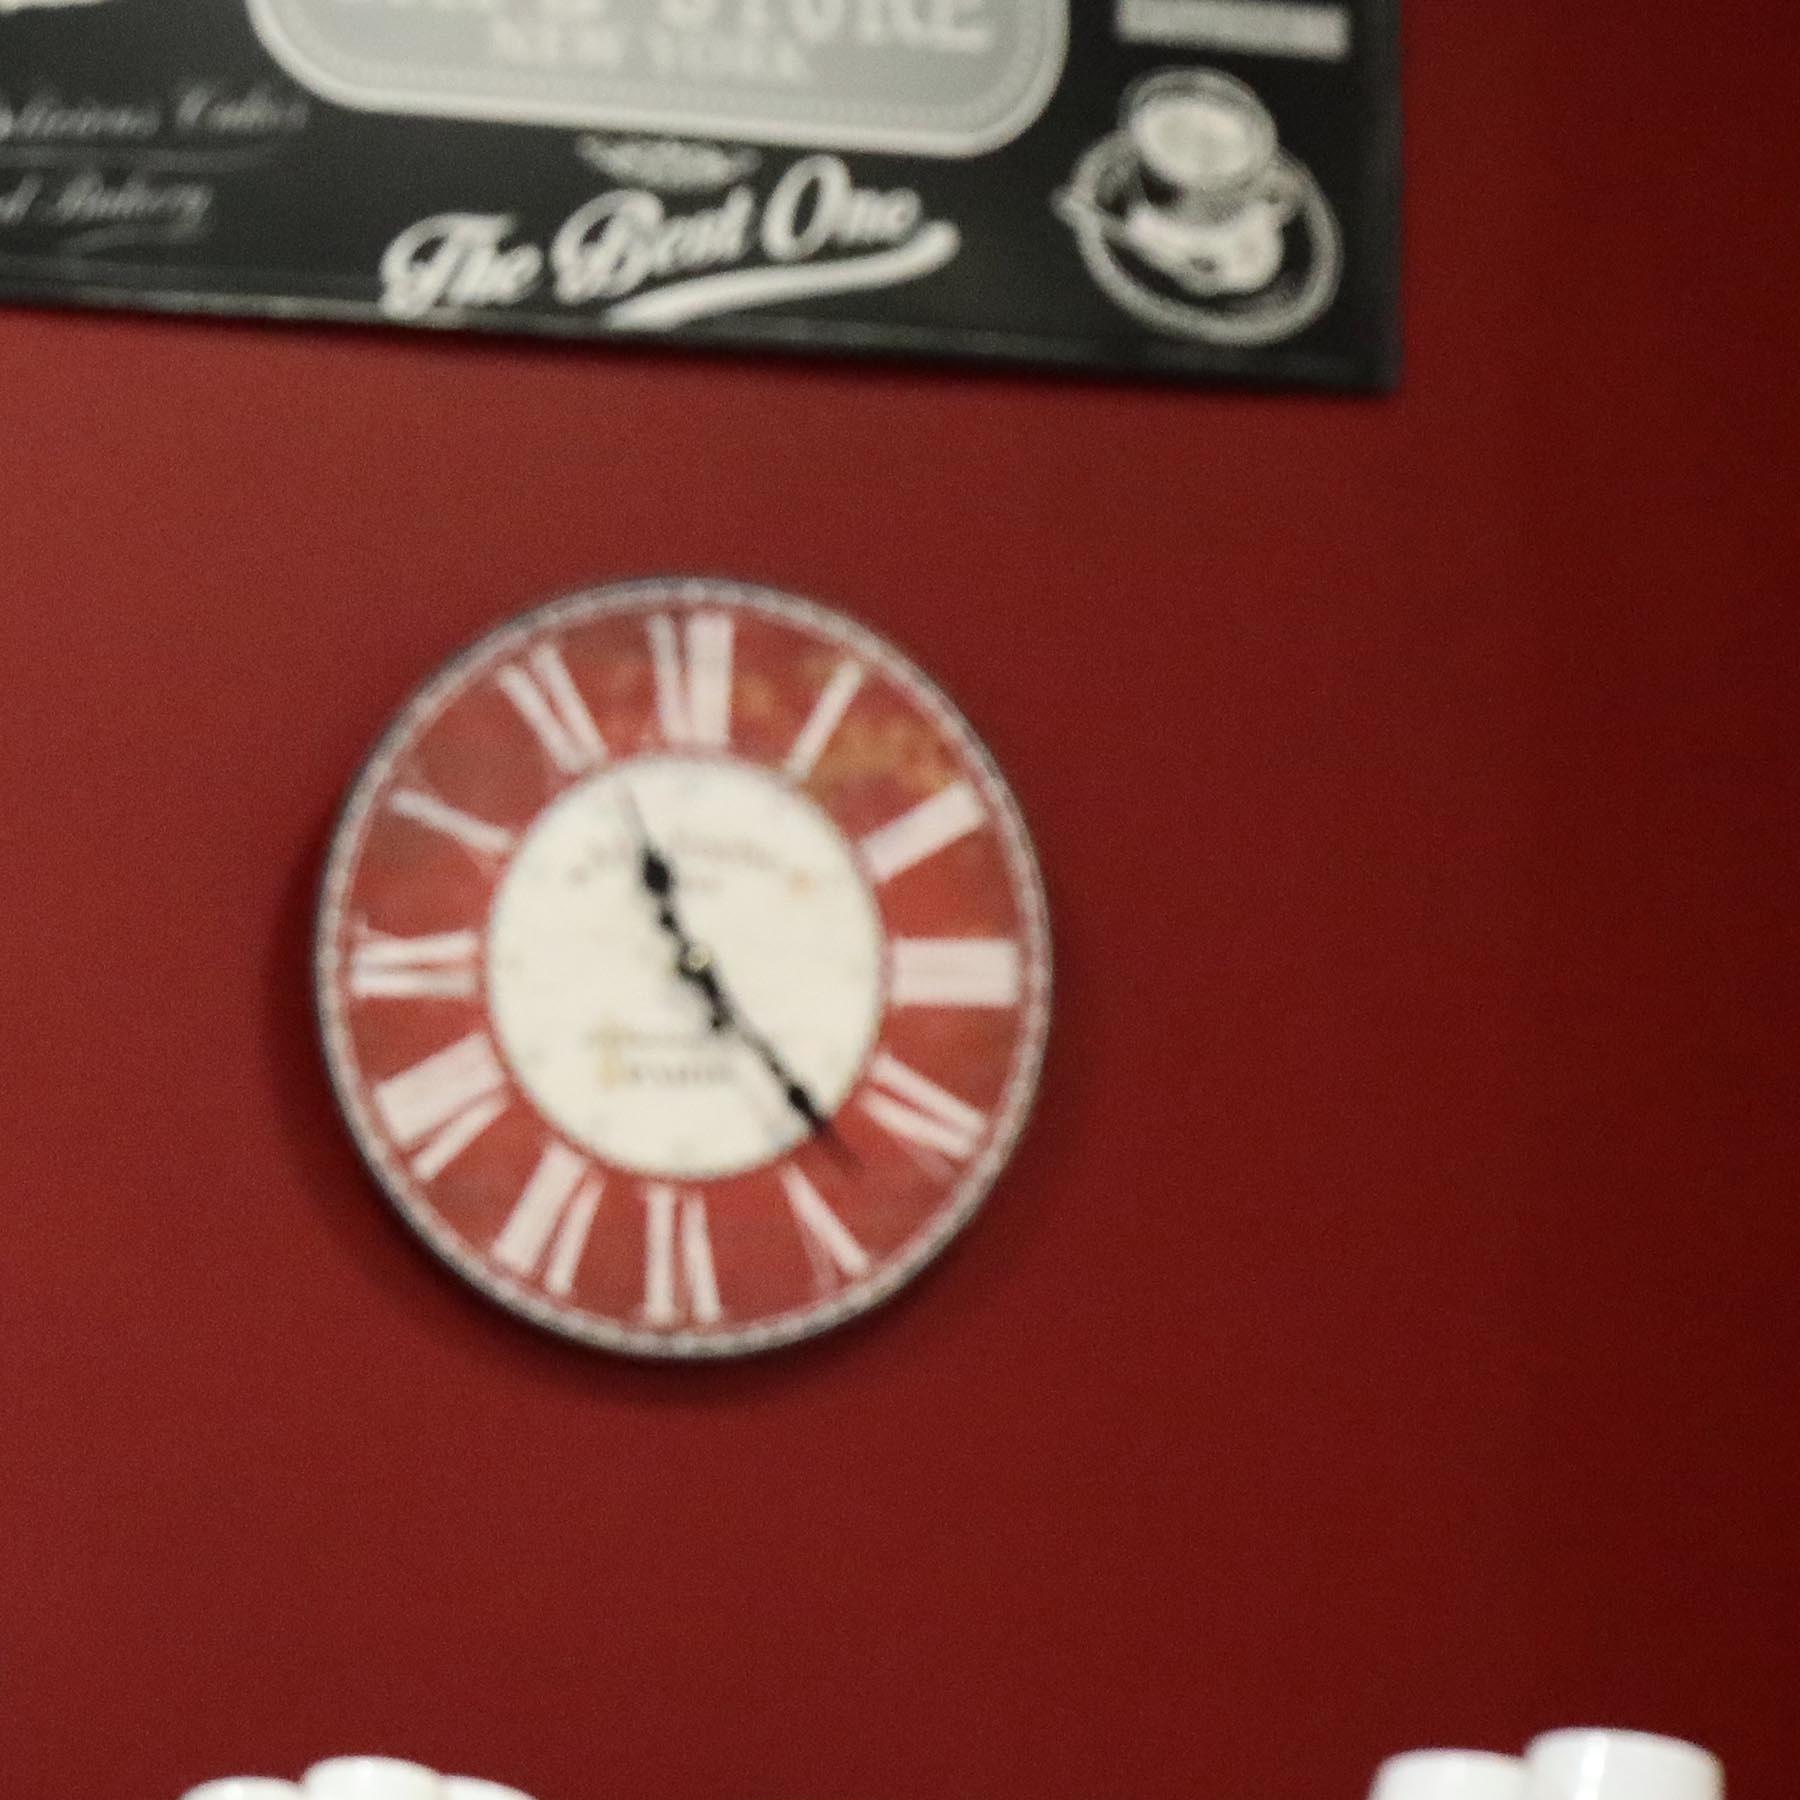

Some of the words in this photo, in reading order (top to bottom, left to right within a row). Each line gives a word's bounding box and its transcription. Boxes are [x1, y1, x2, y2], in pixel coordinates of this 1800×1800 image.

[378, 211, 543, 322] The
[551, 186, 755, 302] Best
[761, 154, 922, 260] One
